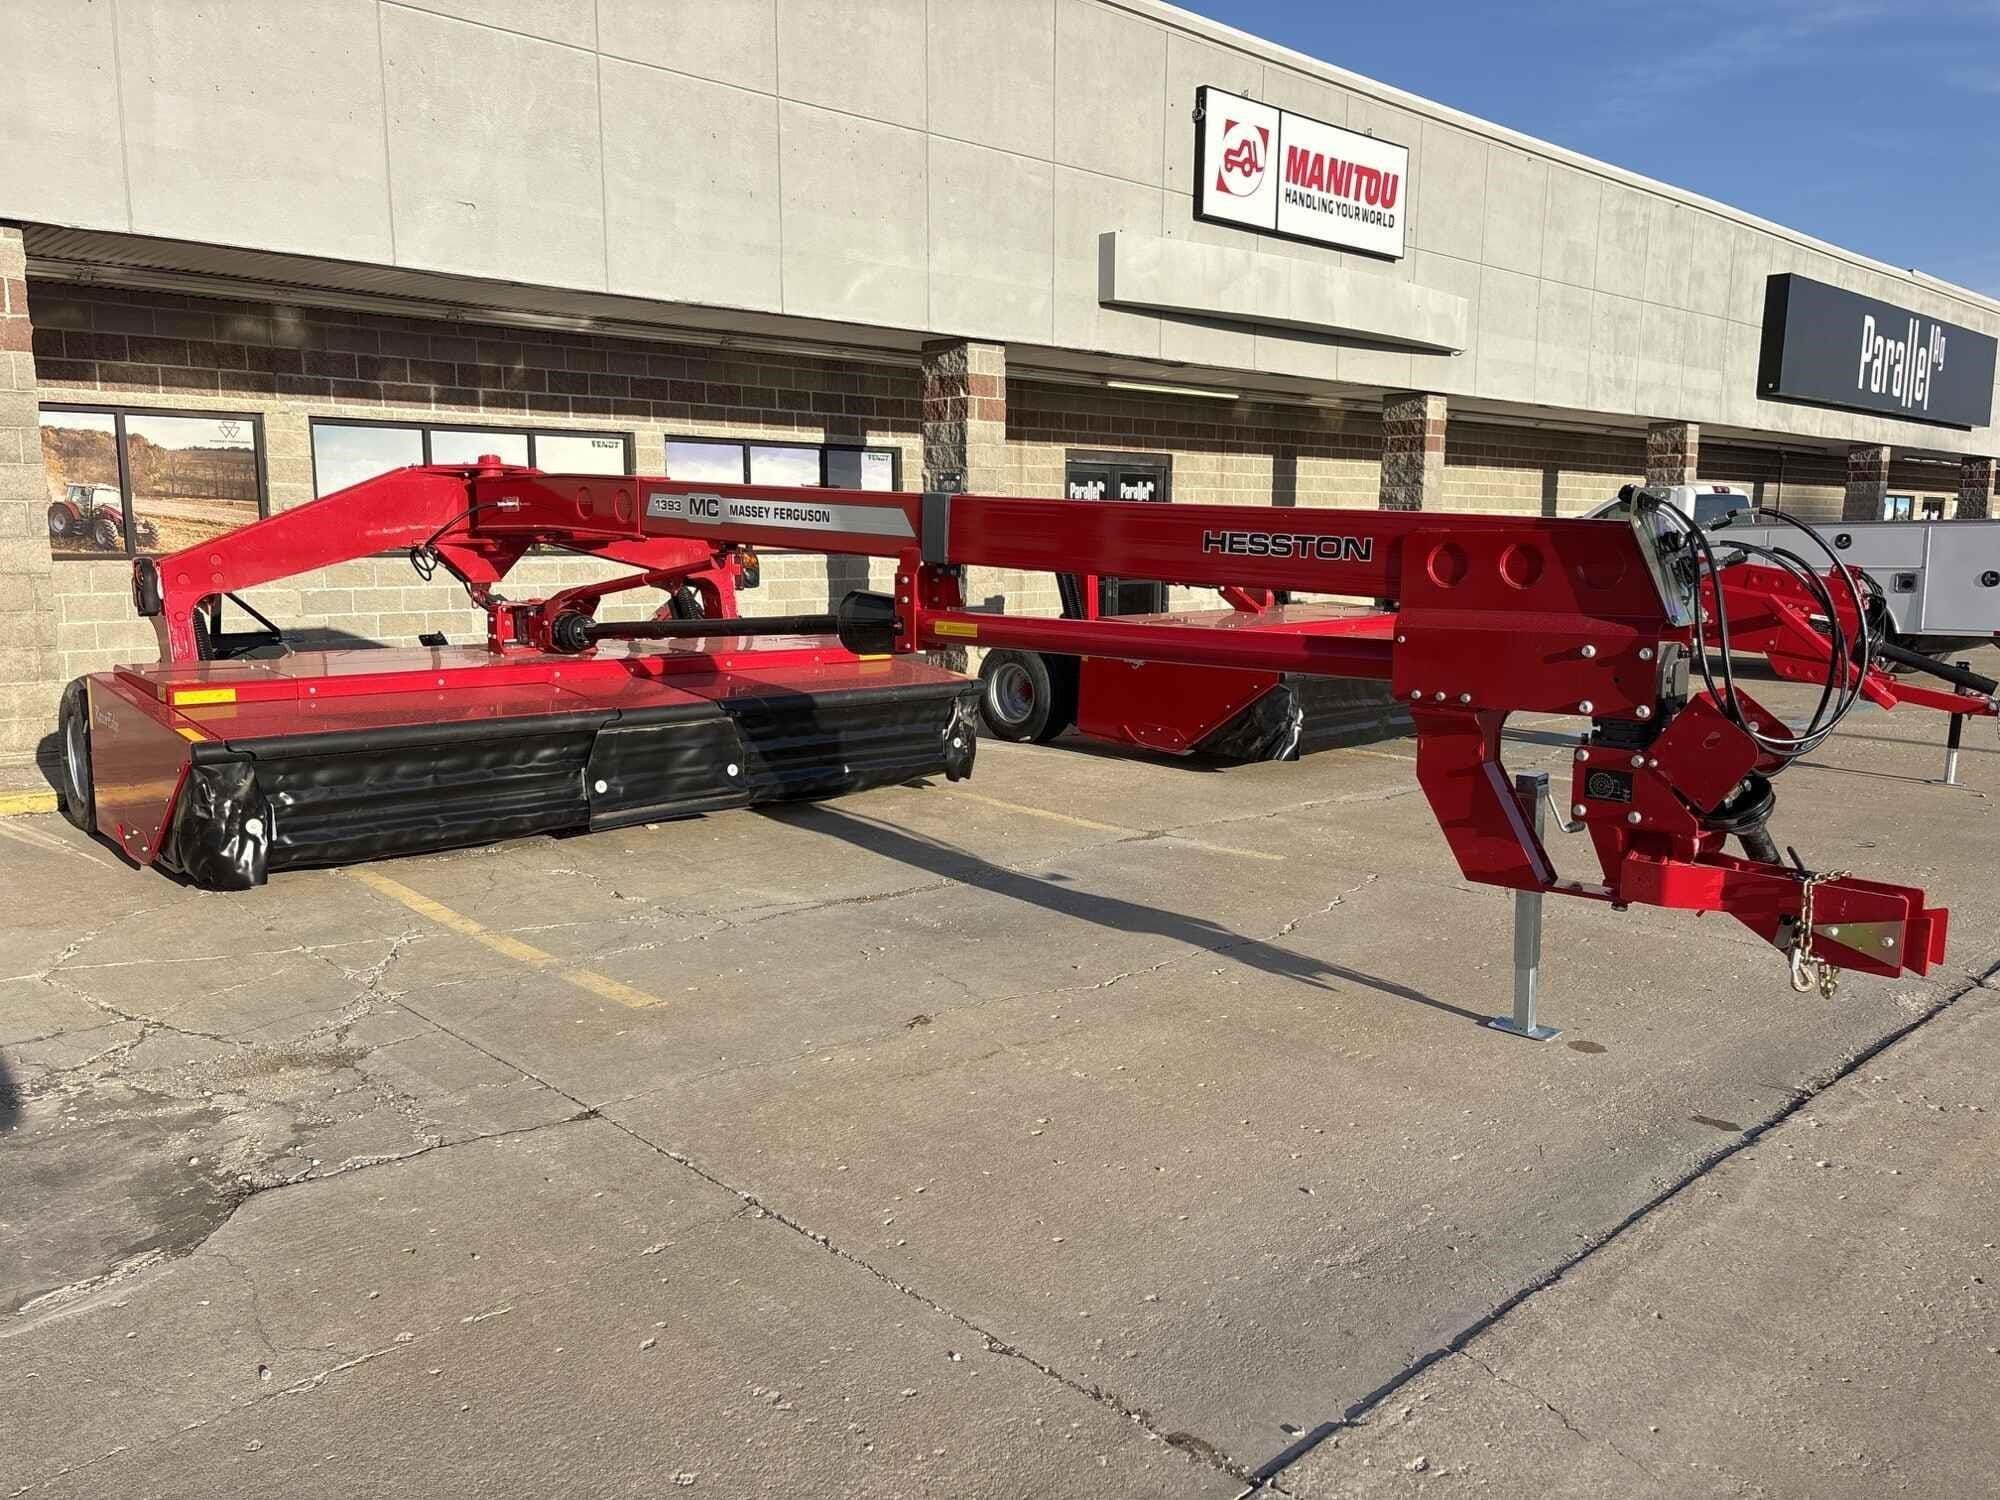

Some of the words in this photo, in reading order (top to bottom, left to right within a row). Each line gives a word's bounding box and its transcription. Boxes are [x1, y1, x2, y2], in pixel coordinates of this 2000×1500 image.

[1285, 145, 1399, 210] MANITOU
[1285, 189, 1333, 213] HANDLING
[1336, 200, 1361, 222] YOUR
[1362, 206, 1395, 229] WORLD
[1858, 314, 1935, 411] Parallel
[1070, 481, 1101, 501] Parallel
[1120, 481, 1150, 501] Parallel
[655, 500, 681, 511] 1393
[689, 498, 719, 517] MC
[729, 504, 770, 519] MASSEY
[774, 507, 830, 523] FERGUSON
[1203, 530, 1373, 562] HESSTON
